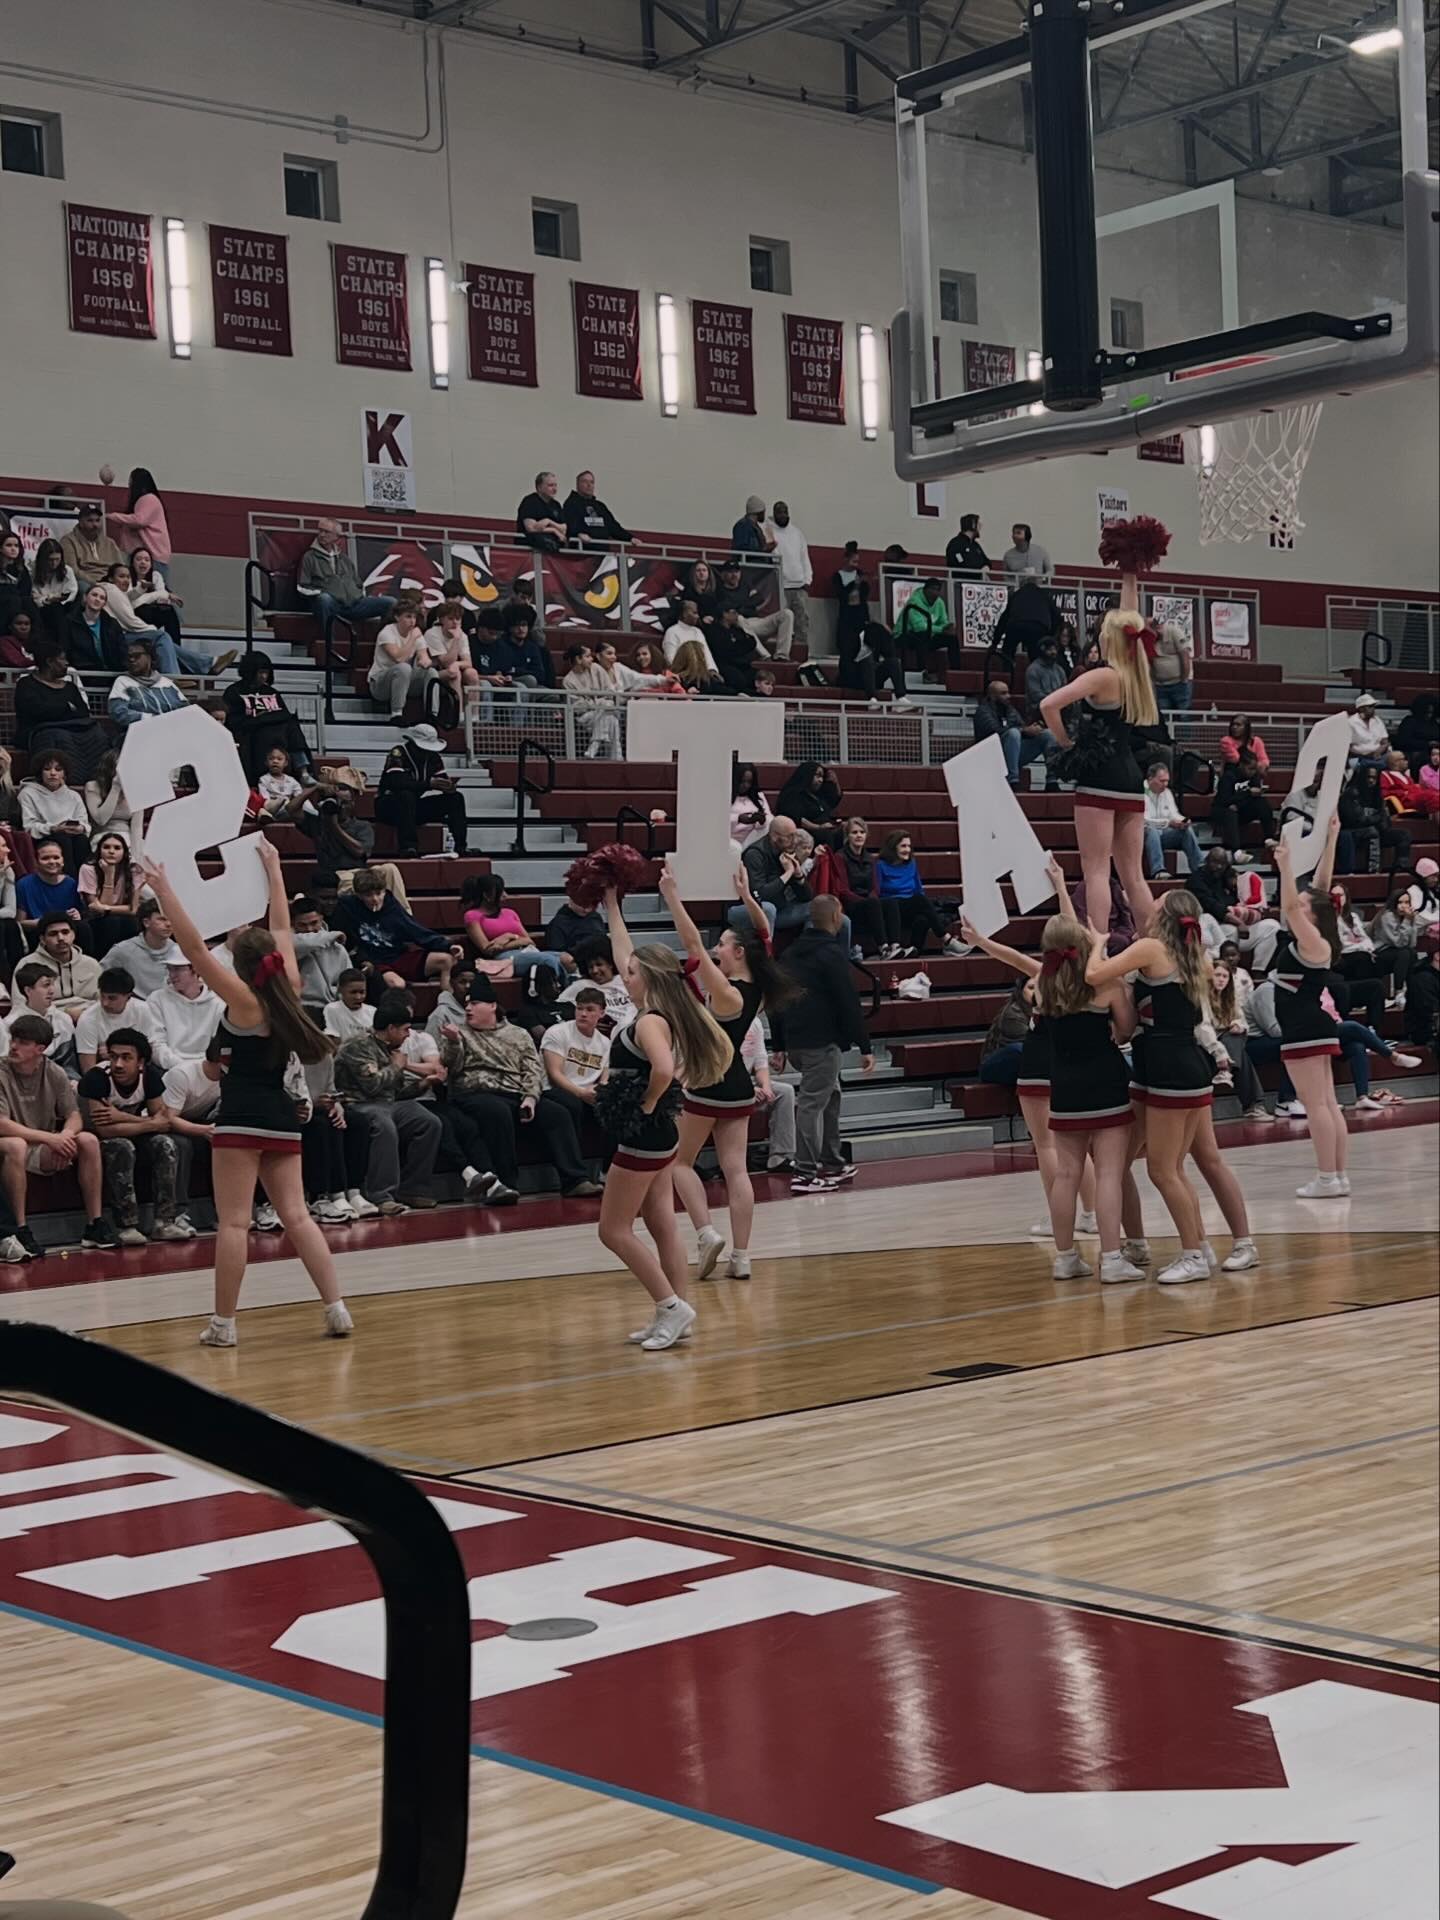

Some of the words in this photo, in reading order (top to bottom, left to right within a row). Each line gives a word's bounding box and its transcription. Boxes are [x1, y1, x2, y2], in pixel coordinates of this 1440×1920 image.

[70, 214, 149, 242] NATIONAL
[75, 239, 148, 264] CHAMPS
[223, 237, 276, 260] STATE
[216, 259, 284, 284] CHAMPS
[347, 255, 396, 278] STATE
[92, 267, 133, 288] 1958
[340, 274, 404, 298] CHAMPS
[478, 274, 524, 296] STATE
[83, 294, 144, 313] FOOTBALL
[234, 288, 270, 308] 1961
[471, 293, 532, 316] CHAMPS
[587, 294, 627, 313] STATE
[358, 298, 390, 318] 1961
[223, 312, 282, 331] FOOTBALL
[361, 320, 389, 333] BOYS
[487, 315, 519, 334] 1961
[582, 316, 634, 337] CHAMPS
[702, 309, 743, 329] STATE
[342, 333, 408, 352] BASKETBALL
[490, 335, 517, 350] BOYS
[697, 326, 749, 348] CHAMPS
[796, 324, 834, 343] STATE
[485, 349, 520, 365] TRACK
[593, 340, 626, 359] 1962
[709, 348, 739, 366] 1962
[791, 341, 840, 361] CHAMPS
[974, 350, 1009, 367] STATE
[589, 363, 632, 379] FOOTBALL
[713, 367, 737, 380] BOYS
[802, 361, 831, 378] 1963
[710, 381, 740, 395] TRACK
[806, 381, 829, 392] BOYS
[792, 391, 844, 408] BASKETBALL
[365, 410, 408, 467] K
[916, 482, 939, 517] L
[18, 522, 49, 538] girls
[626, 701, 785, 901] T
[943, 733, 1057, 940] A
